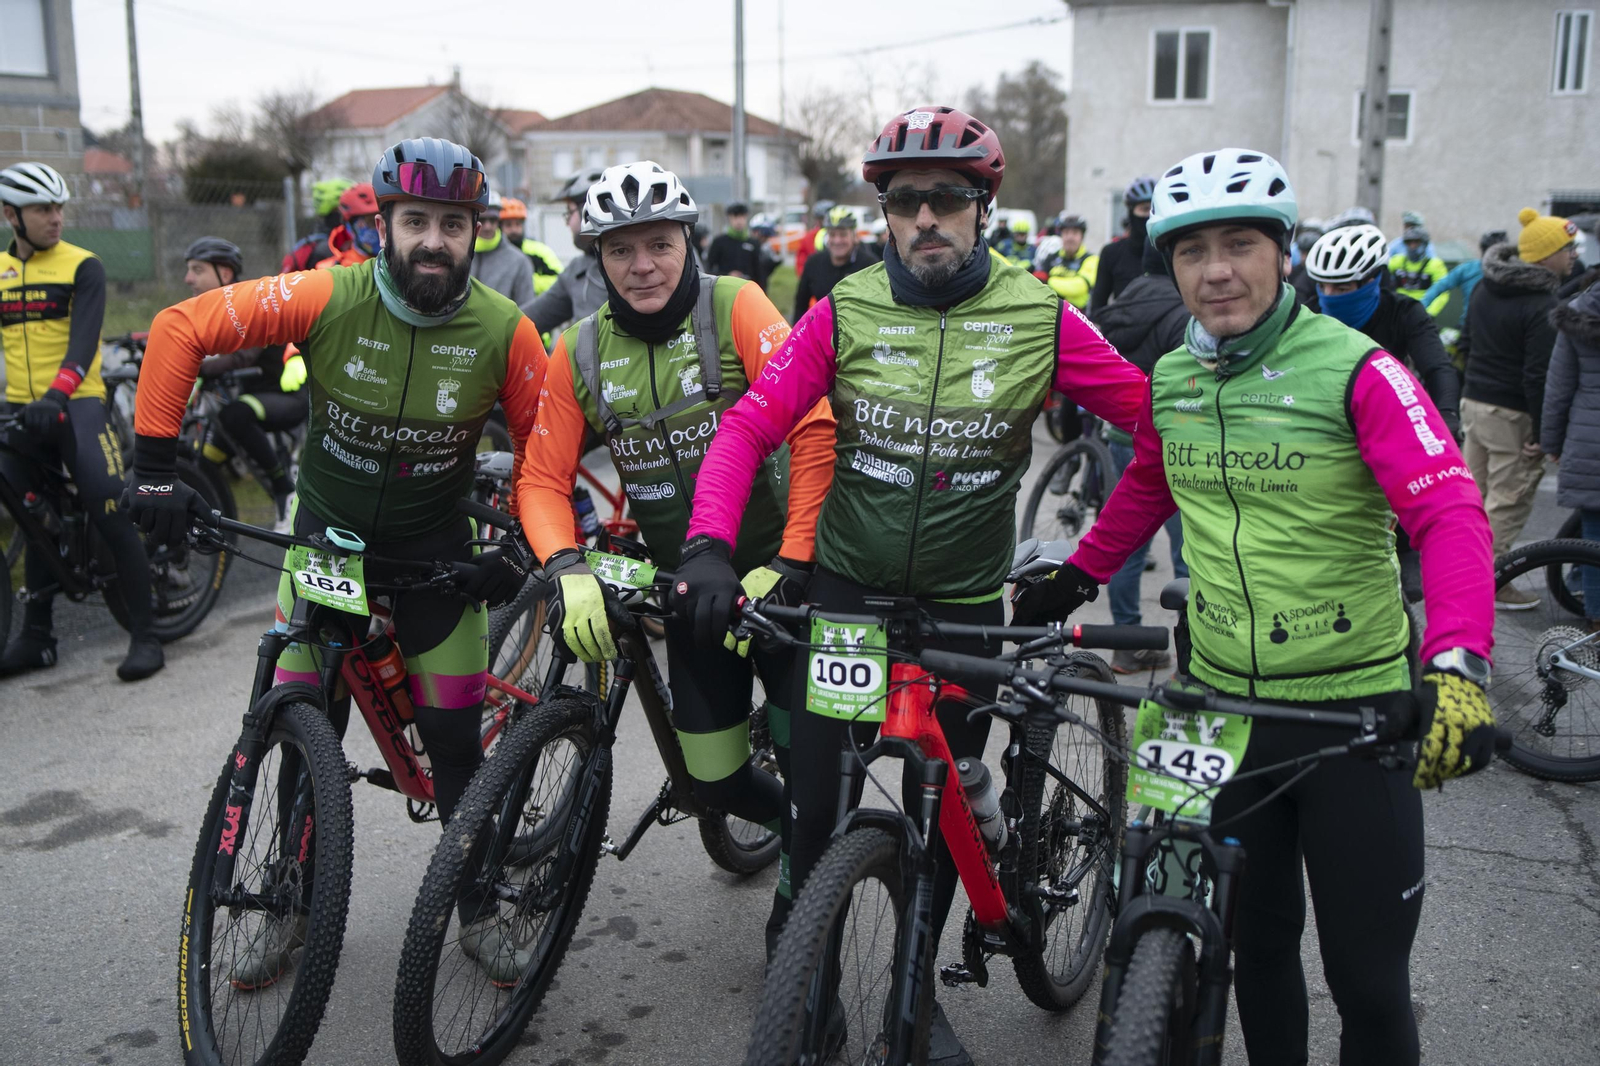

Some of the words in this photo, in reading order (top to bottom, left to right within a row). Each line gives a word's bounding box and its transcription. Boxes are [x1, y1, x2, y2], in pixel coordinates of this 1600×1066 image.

[226, 299, 247, 339] nocelo
[878, 326, 916, 335] FASTER
[357, 336, 390, 352] FASTER
[983, 334, 1013, 347] sport
[449, 356, 476, 368] sport
[600, 357, 631, 371] FASTER
[892, 350, 906, 358] BAR
[356, 372, 388, 386] FELEMANA
[363, 366, 377, 376] BAR
[610, 388, 638, 401] FELEMANA
[613, 384, 626, 392] BAR
[1173, 399, 1204, 412] Vidal
[1371, 355, 1419, 407] Rancho
[1406, 405, 1447, 457] Grande
[326, 400, 368, 434] Btt
[370, 425, 471, 444] nocelo
[853, 399, 900, 429] Btt
[904, 413, 1013, 439] nocelo
[328, 421, 387, 454] Pedaleando
[398, 445, 424, 454] Pola
[611, 438, 641, 457] Btt
[646, 410, 719, 454] nocel
[859, 430, 925, 455] Pedaleando
[930, 442, 958, 458] Pola
[961, 445, 994, 460] Limia
[322, 433, 363, 463] Allianz
[322, 440, 331, 452] EL
[329, 447, 362, 471] CARMEN
[620, 457, 671, 472] Pedaleando
[676, 445, 700, 462] Pola
[1166, 442, 1200, 468] Btt
[1206, 443, 1311, 470] nocelo
[852, 461, 861, 472] EL
[859, 464, 895, 484] CARMEN
[855, 449, 898, 474] Allianz
[625, 483, 660, 493] Allianz
[952, 469, 1002, 485] PUCHO
[1171, 473, 1228, 491] Pedaleando
[1226, 475, 1256, 492] Pola
[1260, 479, 1299, 493] Limia
[1407, 473, 1435, 496] Btt
[637, 491, 663, 500] CARMEN
[604, 563, 623, 572] COCIDO
[302, 573, 355, 596] 164
[816, 658, 871, 689] 100
[1147, 744, 1227, 784] 143
[218, 803, 243, 856] FOX
[179, 934, 190, 1033] SCORPION
